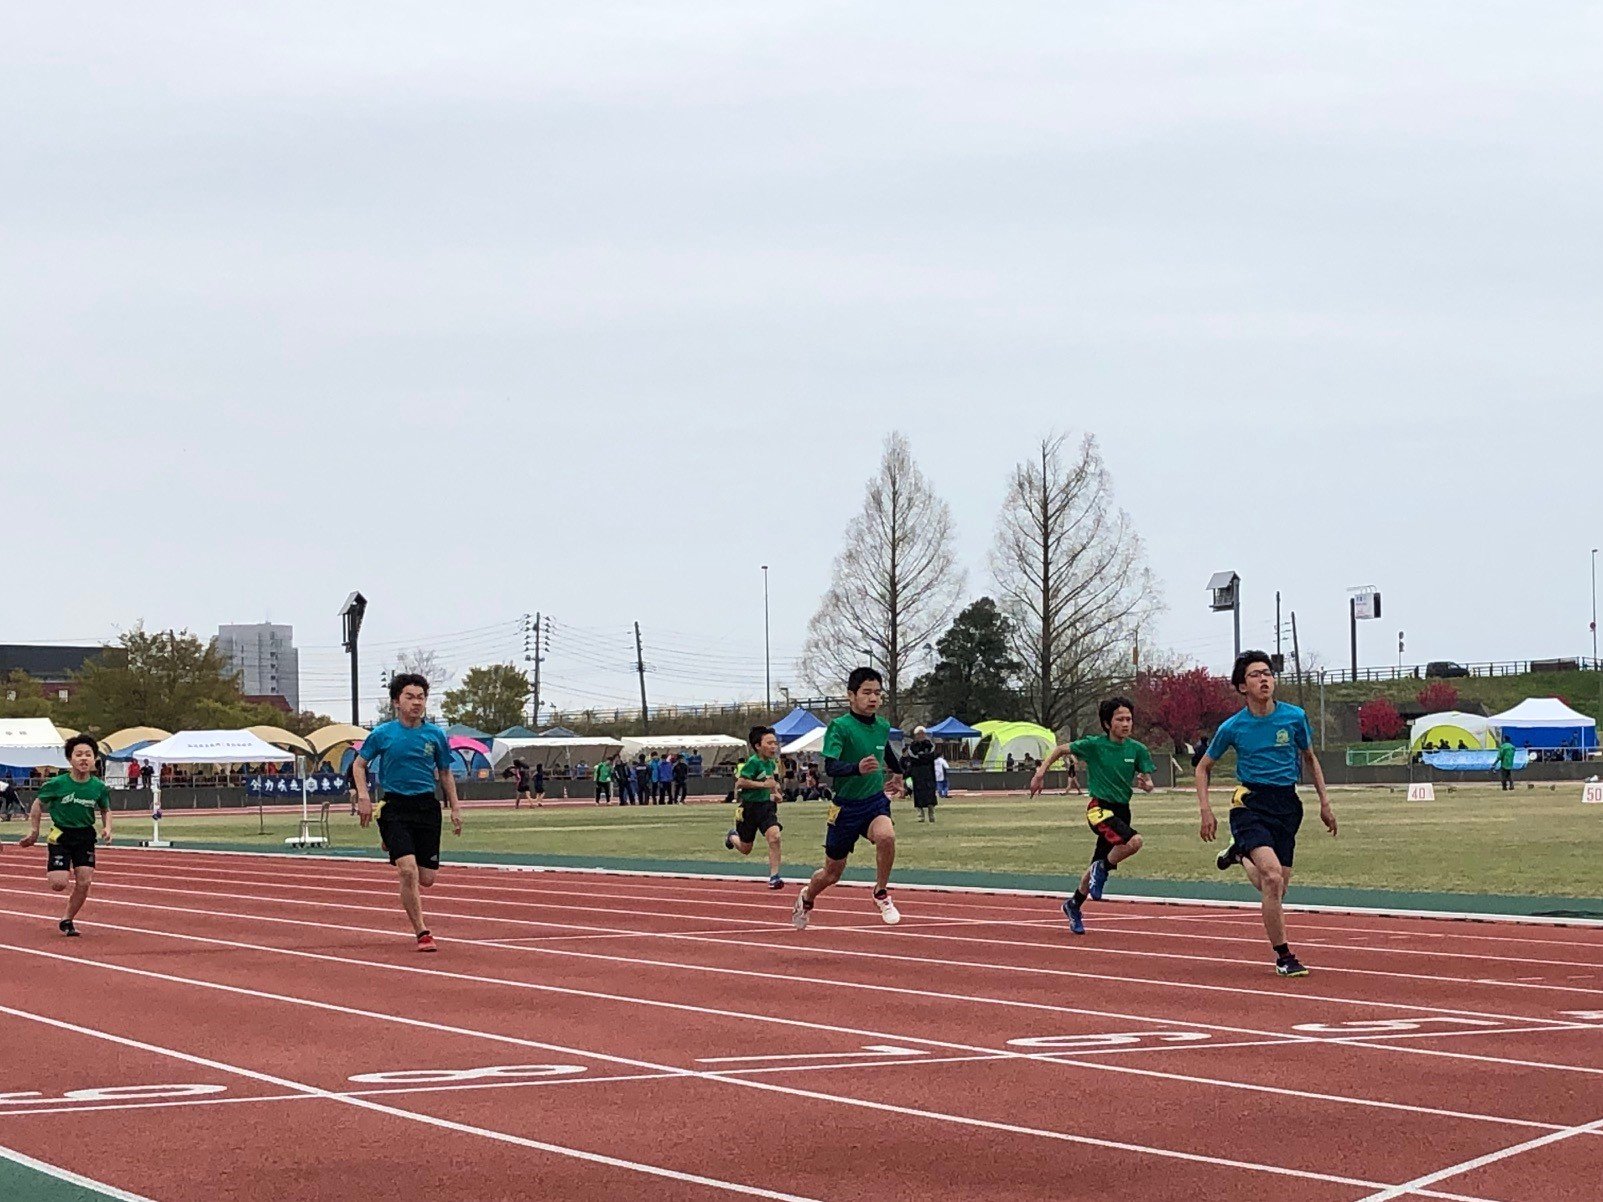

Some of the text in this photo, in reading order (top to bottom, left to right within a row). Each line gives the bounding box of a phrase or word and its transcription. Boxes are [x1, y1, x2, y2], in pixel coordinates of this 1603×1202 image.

[1411, 787, 1426, 800] 40
[1586, 787, 1602, 801] 50
[347, 1064, 588, 1083] 8
